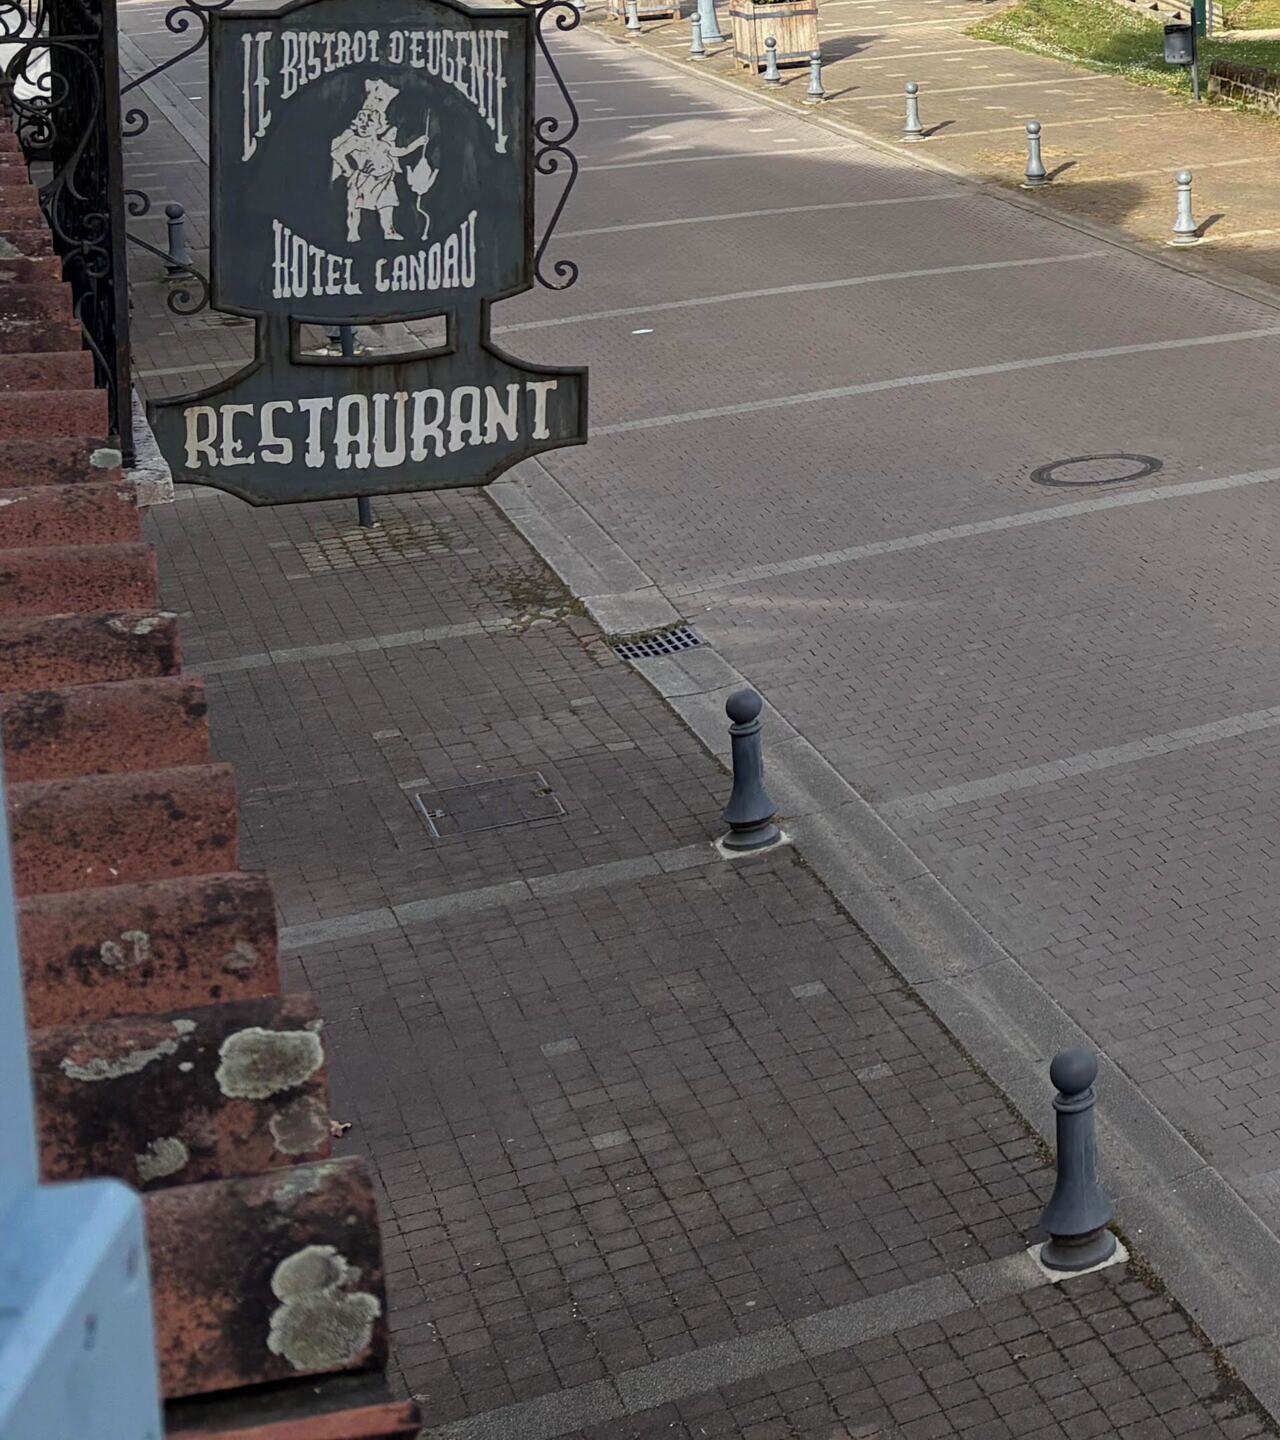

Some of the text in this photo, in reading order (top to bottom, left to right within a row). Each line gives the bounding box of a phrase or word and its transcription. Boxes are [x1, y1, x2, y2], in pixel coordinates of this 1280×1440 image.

[241, 30, 509, 161] LE BISTROT D'EUGENIE
[272, 210, 478, 299] HOTEL CANDAU
[184, 380, 558, 469] RESTAURANT
